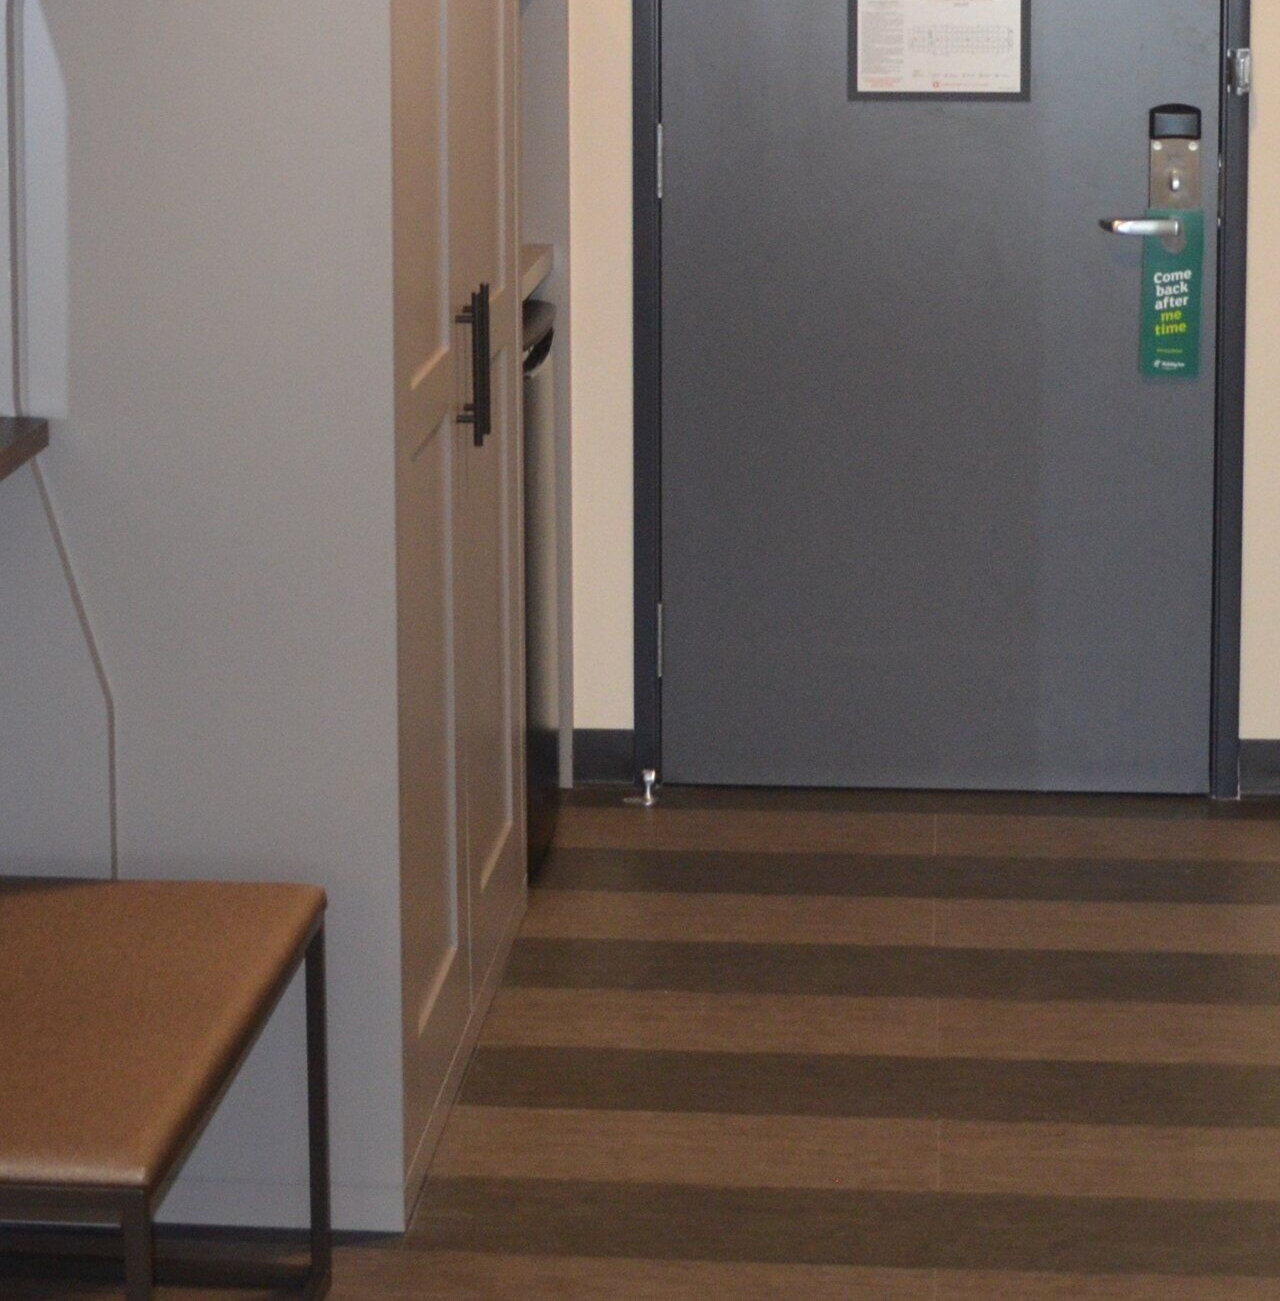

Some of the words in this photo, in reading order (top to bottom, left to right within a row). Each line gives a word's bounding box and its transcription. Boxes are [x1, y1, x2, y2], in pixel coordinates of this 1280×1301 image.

[1153, 269, 1192, 284] Come
[1156, 281, 1189, 297] back
[1155, 296, 1189, 310] after
[1161, 310, 1182, 322] me
[1155, 323, 1187, 335] time
